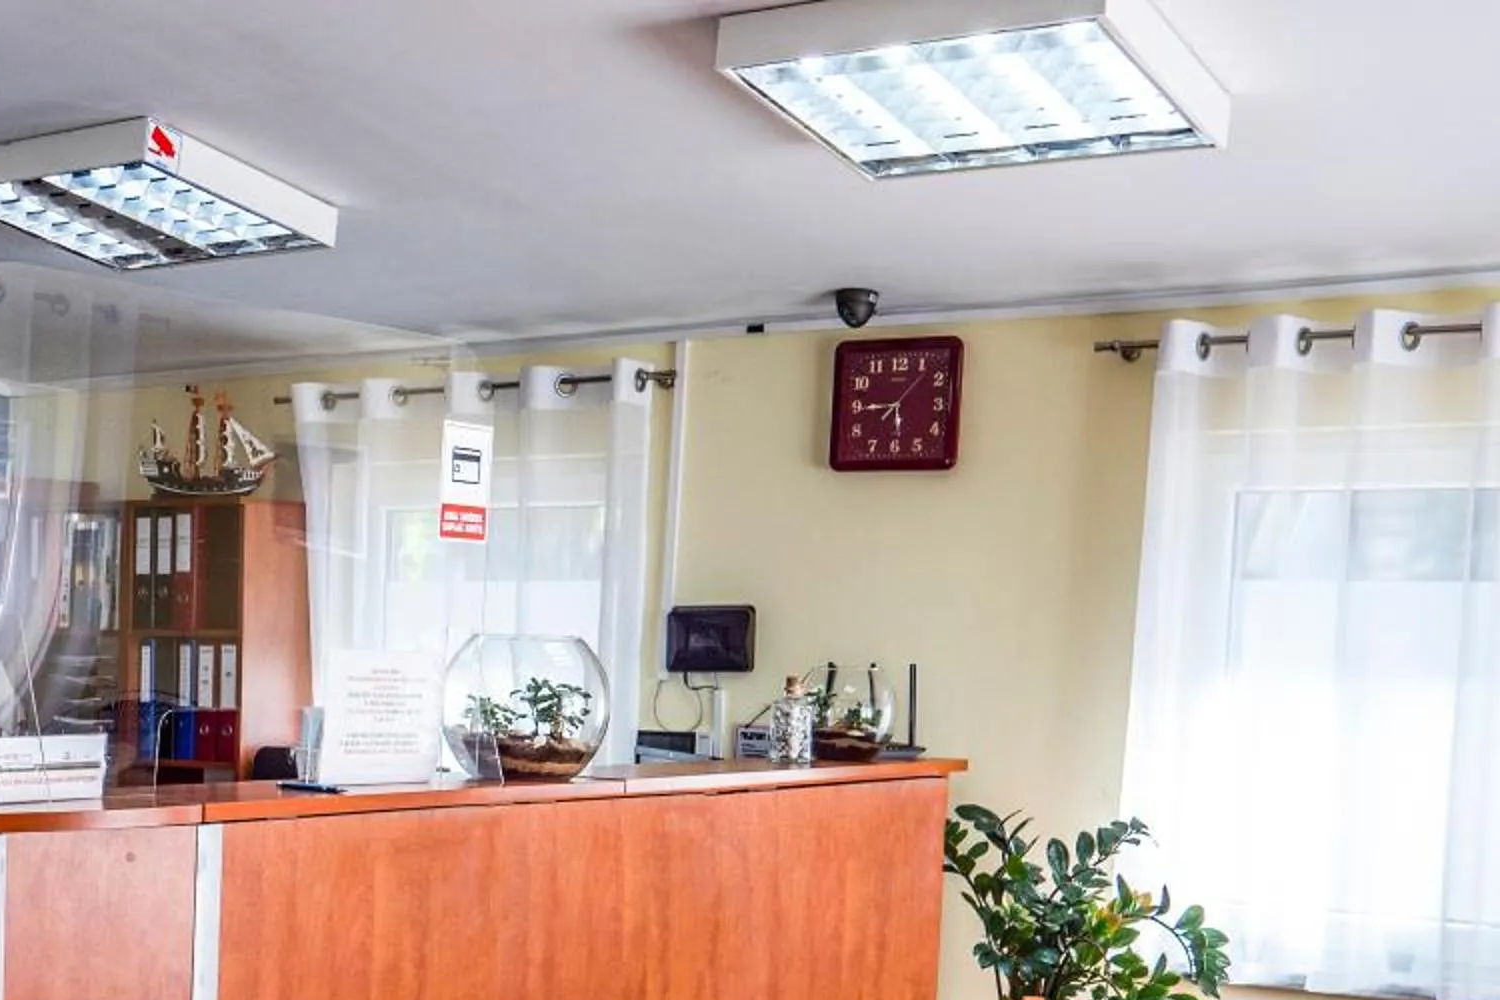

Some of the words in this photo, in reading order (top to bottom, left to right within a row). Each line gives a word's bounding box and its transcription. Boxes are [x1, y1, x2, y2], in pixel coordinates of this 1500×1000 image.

[869, 360, 882, 373] 11
[892, 358, 908, 371] 12
[918, 358, 925, 371] 1
[854, 376, 869, 391] 10
[933, 371, 944, 387] 2
[851, 400, 862, 415] 9
[933, 397, 944, 411] 3
[851, 423, 861, 437] 8
[929, 421, 939, 436] 4
[867, 439, 878, 453] 7
[889, 439, 900, 453] 6
[911, 438, 922, 452] 5
